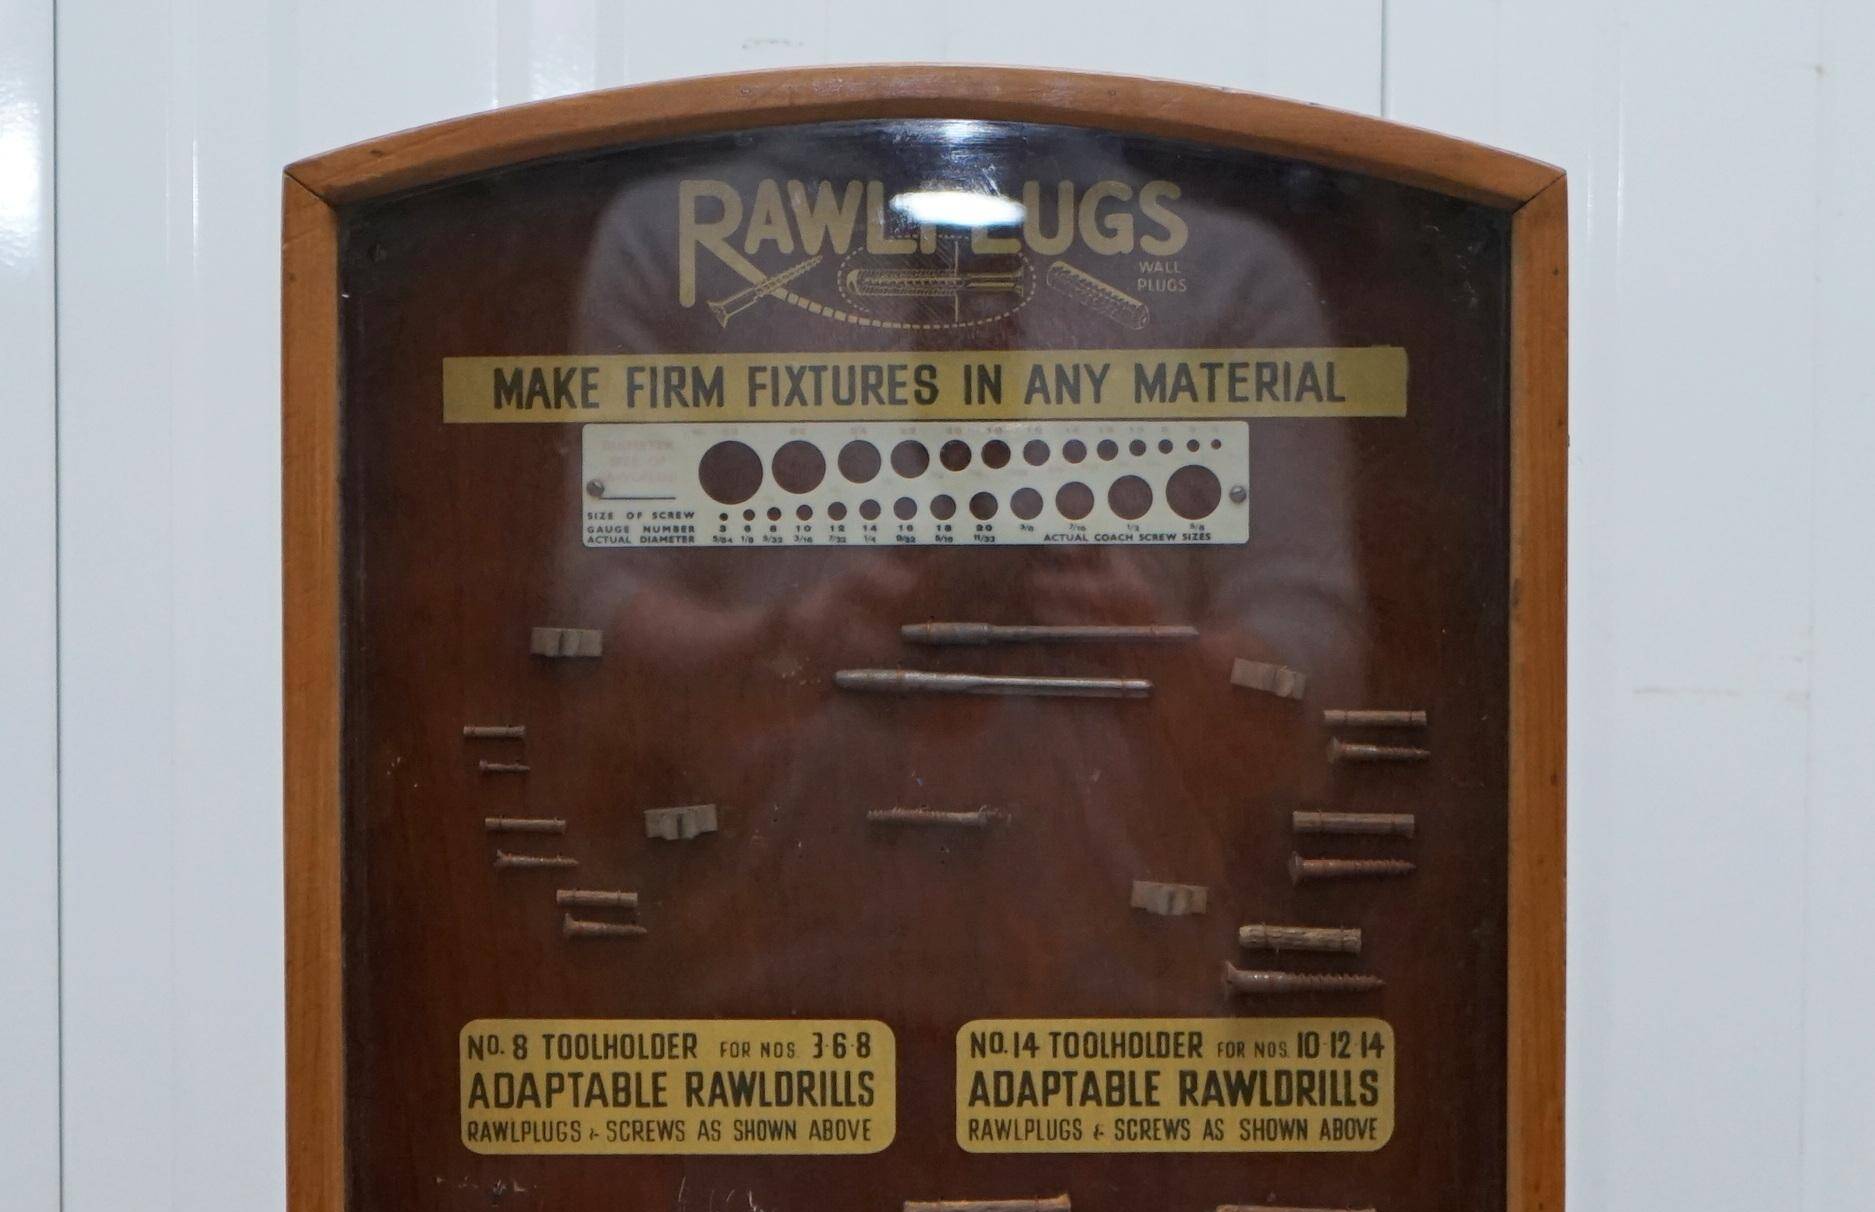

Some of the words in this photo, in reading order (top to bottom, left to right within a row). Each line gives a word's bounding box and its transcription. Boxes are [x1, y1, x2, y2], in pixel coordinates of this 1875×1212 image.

[679, 179, 1189, 307] RAWLLUGS
[1139, 261, 1181, 273] WALL
[1138, 278, 1187, 292] PLUGS
[494, 367, 598, 410] MAKE
[627, 366, 724, 408] FIRM
[748, 364, 939, 407] FIXTURES
[964, 364, 1001, 405] IN
[1024, 363, 1110, 404] ANY
[1135, 361, 1348, 403] MATERIAL
[587, 511, 613, 520] SIZE
[626, 511, 642, 520] OF
[652, 511, 695, 520] SCREW
[587, 525, 630, 534] GAUGE
[643, 525, 695, 534] NUMBER
[795, 524, 812, 533] 10
[862, 523, 877, 532] 14
[587, 536, 632, 544] ACTUAL
[640, 536, 695, 544] DIAMETER
[1043, 533, 1089, 542] ACTUAL
[1094, 533, 1134, 542] COACH
[1139, 533, 1177, 542] SCREW
[1182, 532, 1212, 541] SIZES
[513, 1034, 527, 1060] 8
[542, 1033, 697, 1060] TOOLHOLDER
[720, 1042, 750, 1058] FOR
[1014, 1032, 1039, 1058] 14
[1049, 1032, 1202, 1058] TOOLHOLDER
[1218, 1041, 1245, 1058] FOR
[468, 1072, 667, 1109] ADAPTABLE
[686, 1071, 874, 1107] RAWLDRILLS
[969, 1071, 1160, 1107] ADAPTABLE
[1179, 1070, 1378, 1107] RAWLDRILLS
[468, 1121, 581, 1142] RAWLPLUGS
[607, 1120, 684, 1142] SCREWS
[698, 1120, 720, 1141] AS
[734, 1120, 796, 1141] SHOWN
[809, 1119, 870, 1141] ABOVE
[969, 1118, 1082, 1141] RAWLPLUGS
[1115, 1118, 1190, 1141] SCREWS
[1203, 1119, 1224, 1140] AS
[1240, 1118, 1307, 1141] SHOWN
[1320, 1118, 1377, 1140] ABOVE
